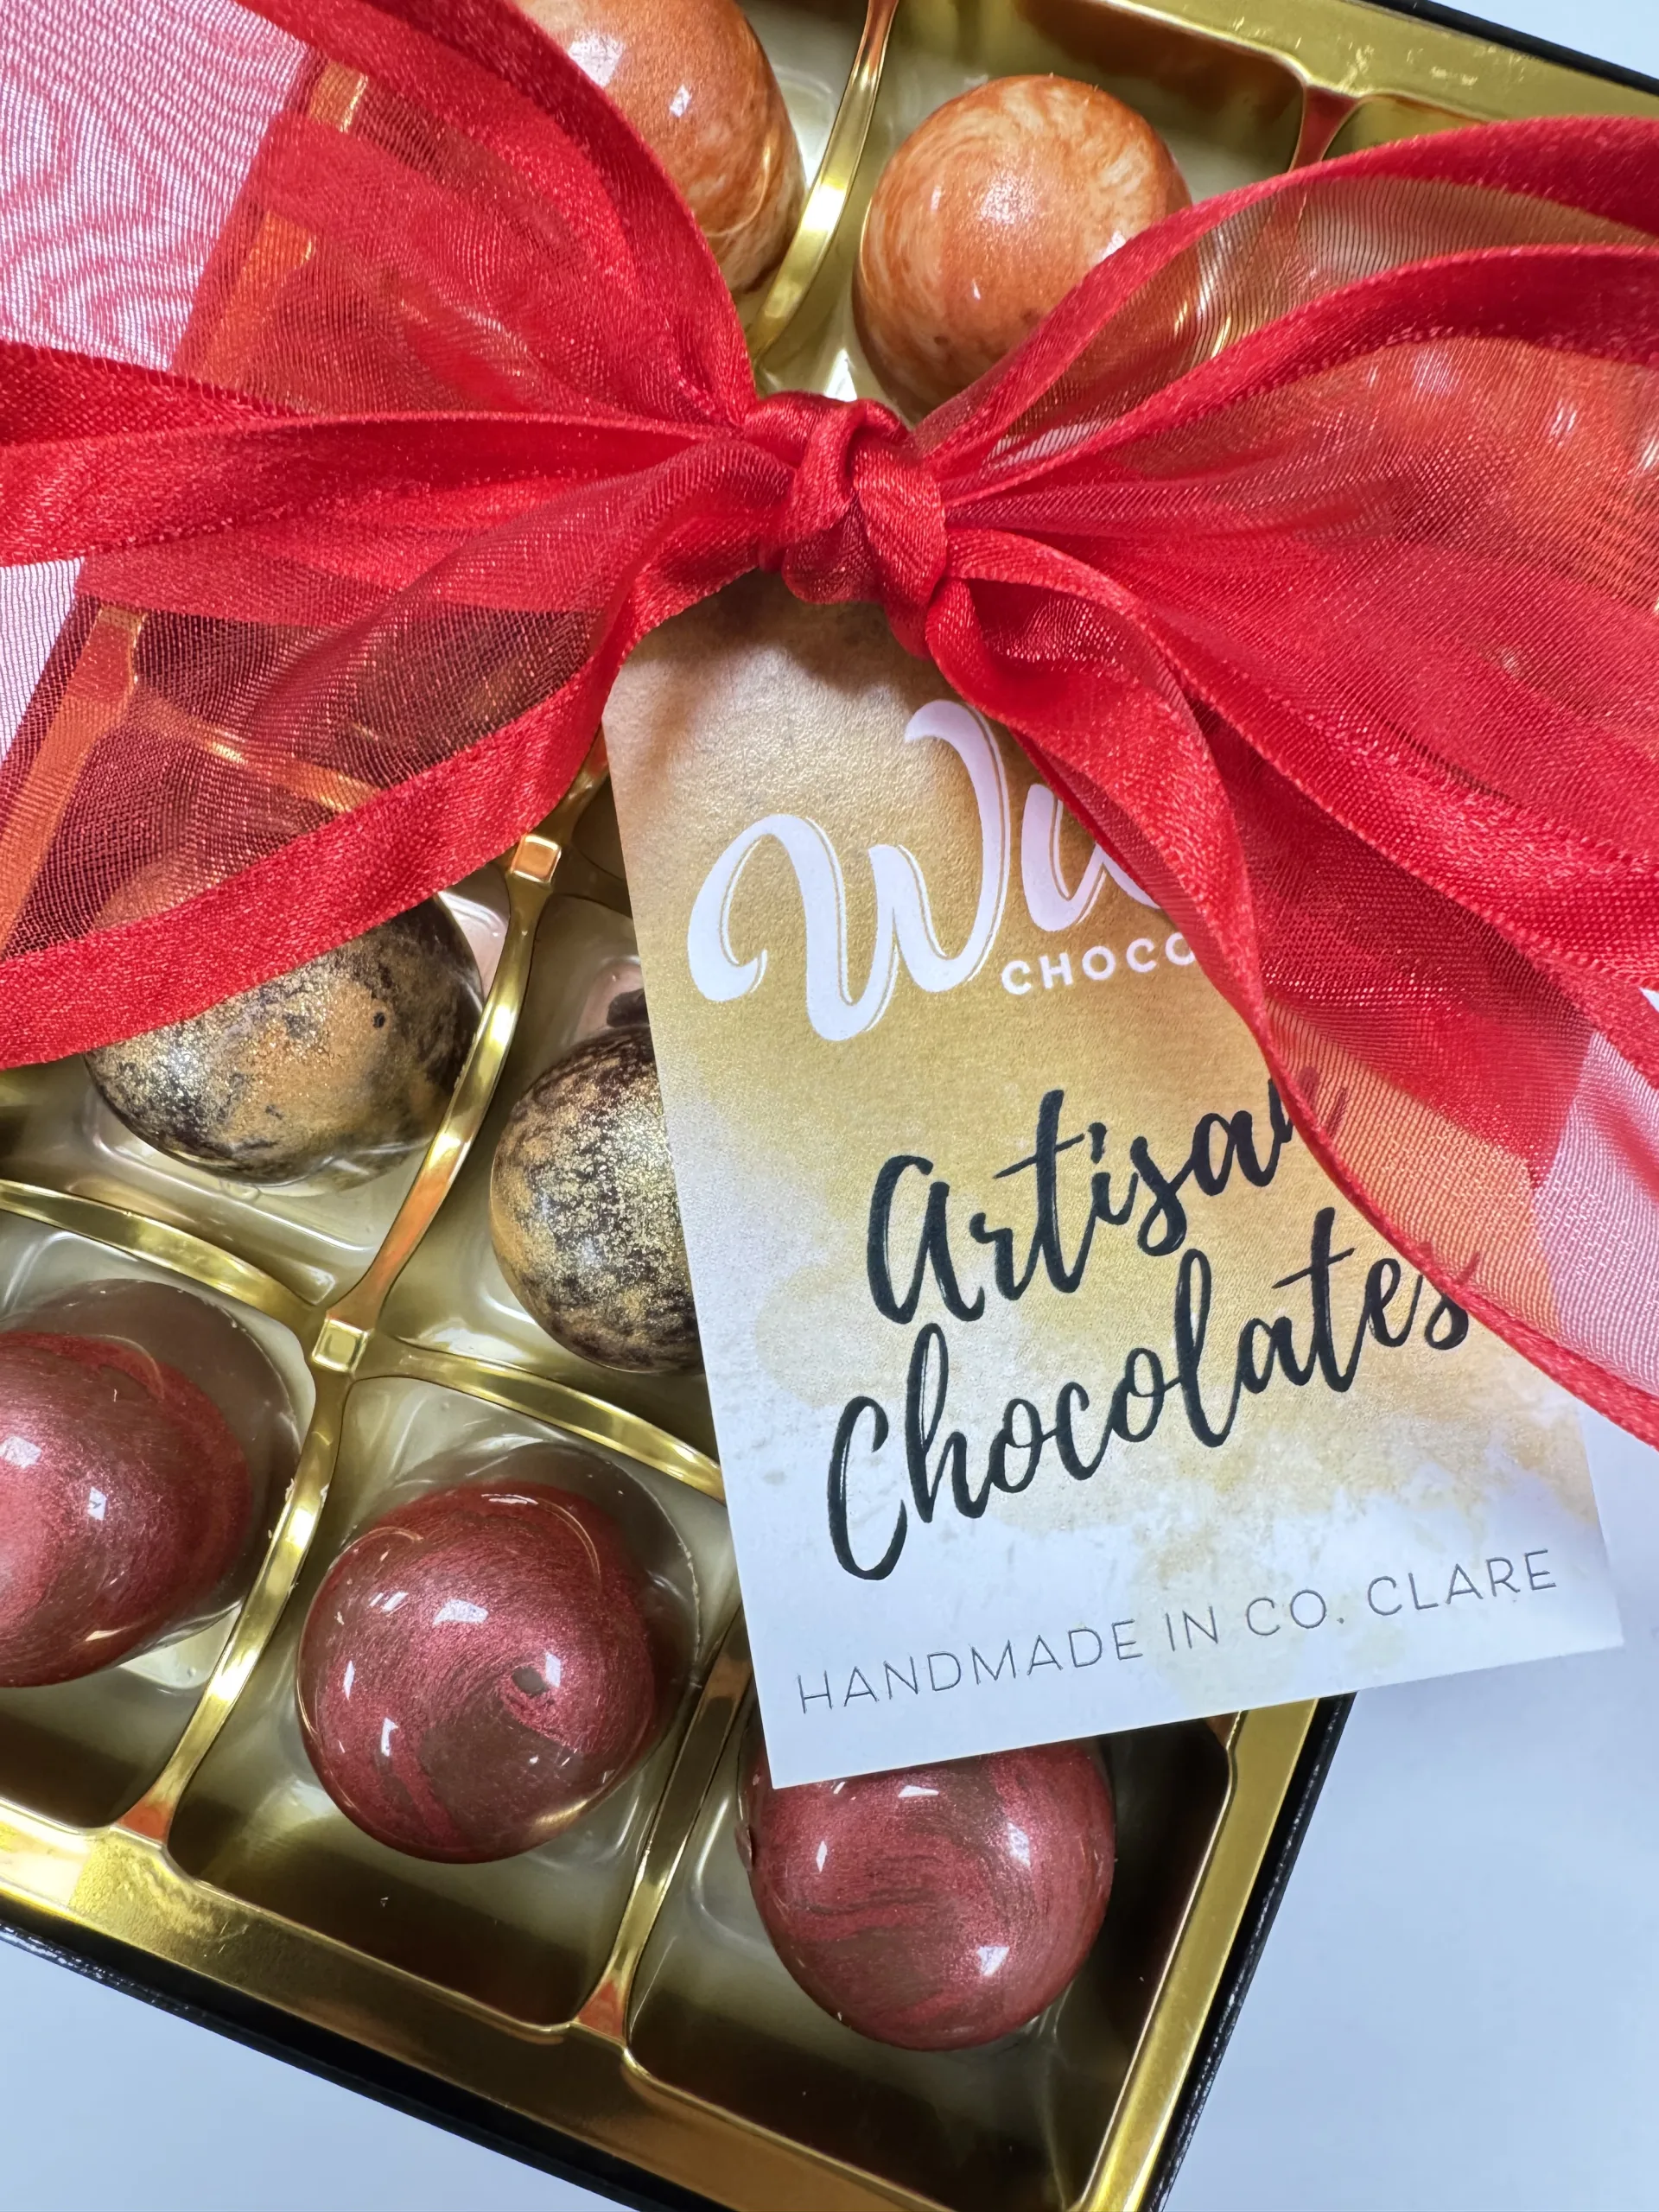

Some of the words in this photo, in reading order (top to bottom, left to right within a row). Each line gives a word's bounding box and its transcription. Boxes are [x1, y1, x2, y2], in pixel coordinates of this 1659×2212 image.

[827, 1207, 1480, 1580] Chocolates
[797, 1618, 1143, 1714] HANDMADE
[1163, 1605, 1221, 1652] IN
[1247, 1588, 1346, 1638] CO.
[1367, 1548, 1557, 1618] CLARE
